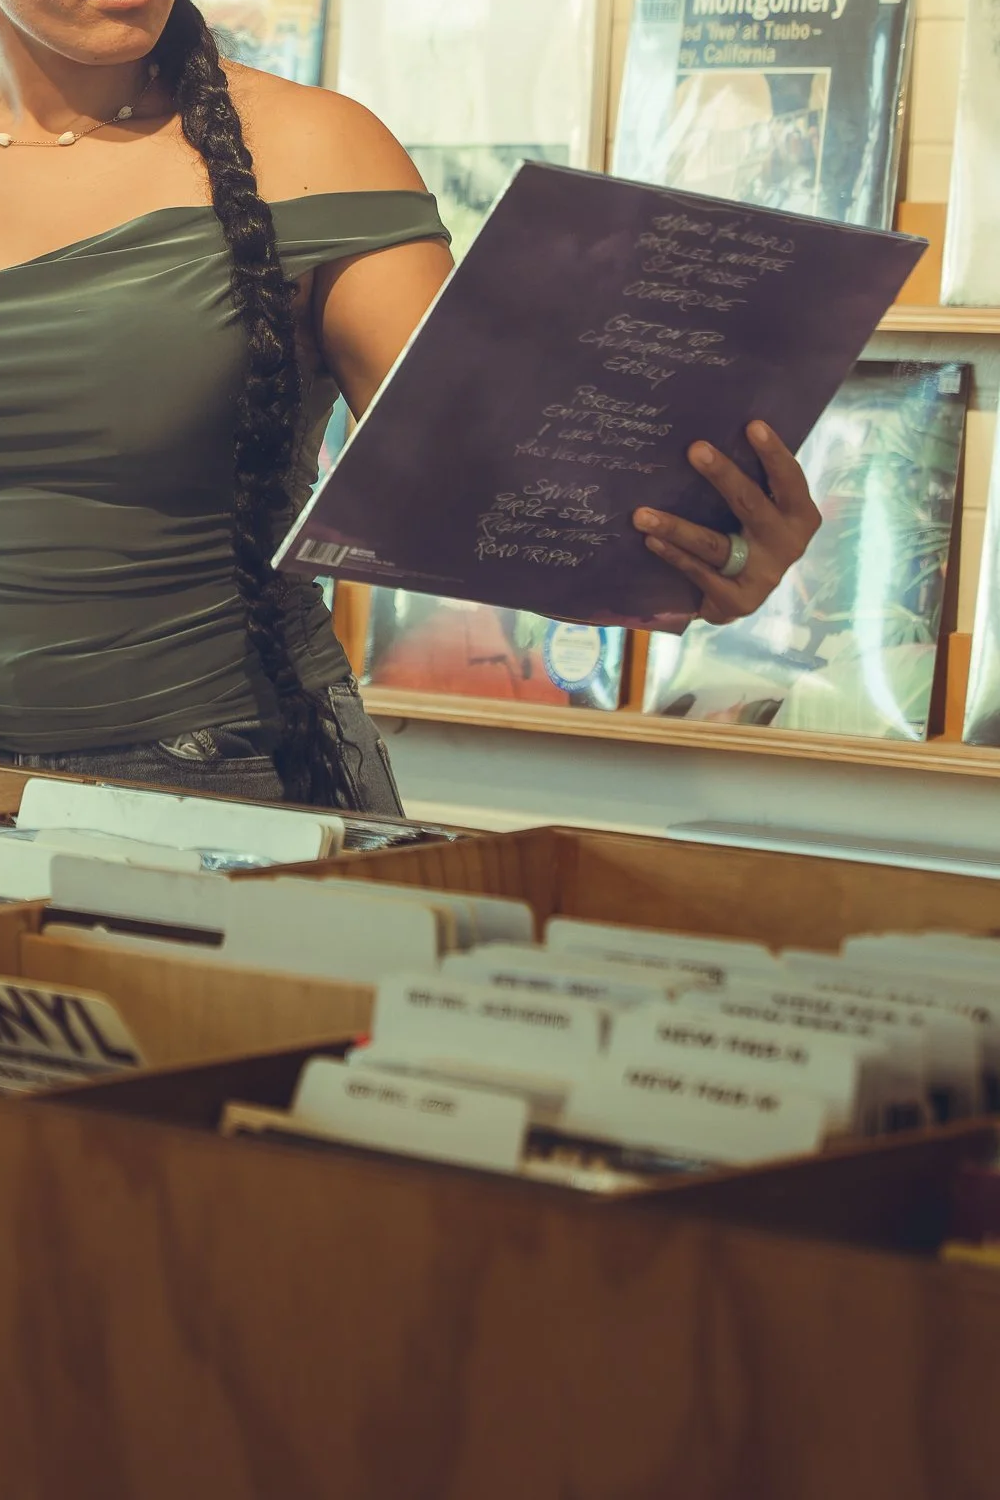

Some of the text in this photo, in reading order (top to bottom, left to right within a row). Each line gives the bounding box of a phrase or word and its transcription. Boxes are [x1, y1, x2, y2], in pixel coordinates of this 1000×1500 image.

[743, 23, 759, 39] at
[703, 43, 776, 65] California
[604, 313, 725, 347] GET ON TOP
[602, 356, 676, 390] EASILY
[572, 385, 669, 418] PORCELAIN
[523, 478, 601, 508] SAVIOR
[474, 536, 519, 561] ROAD
